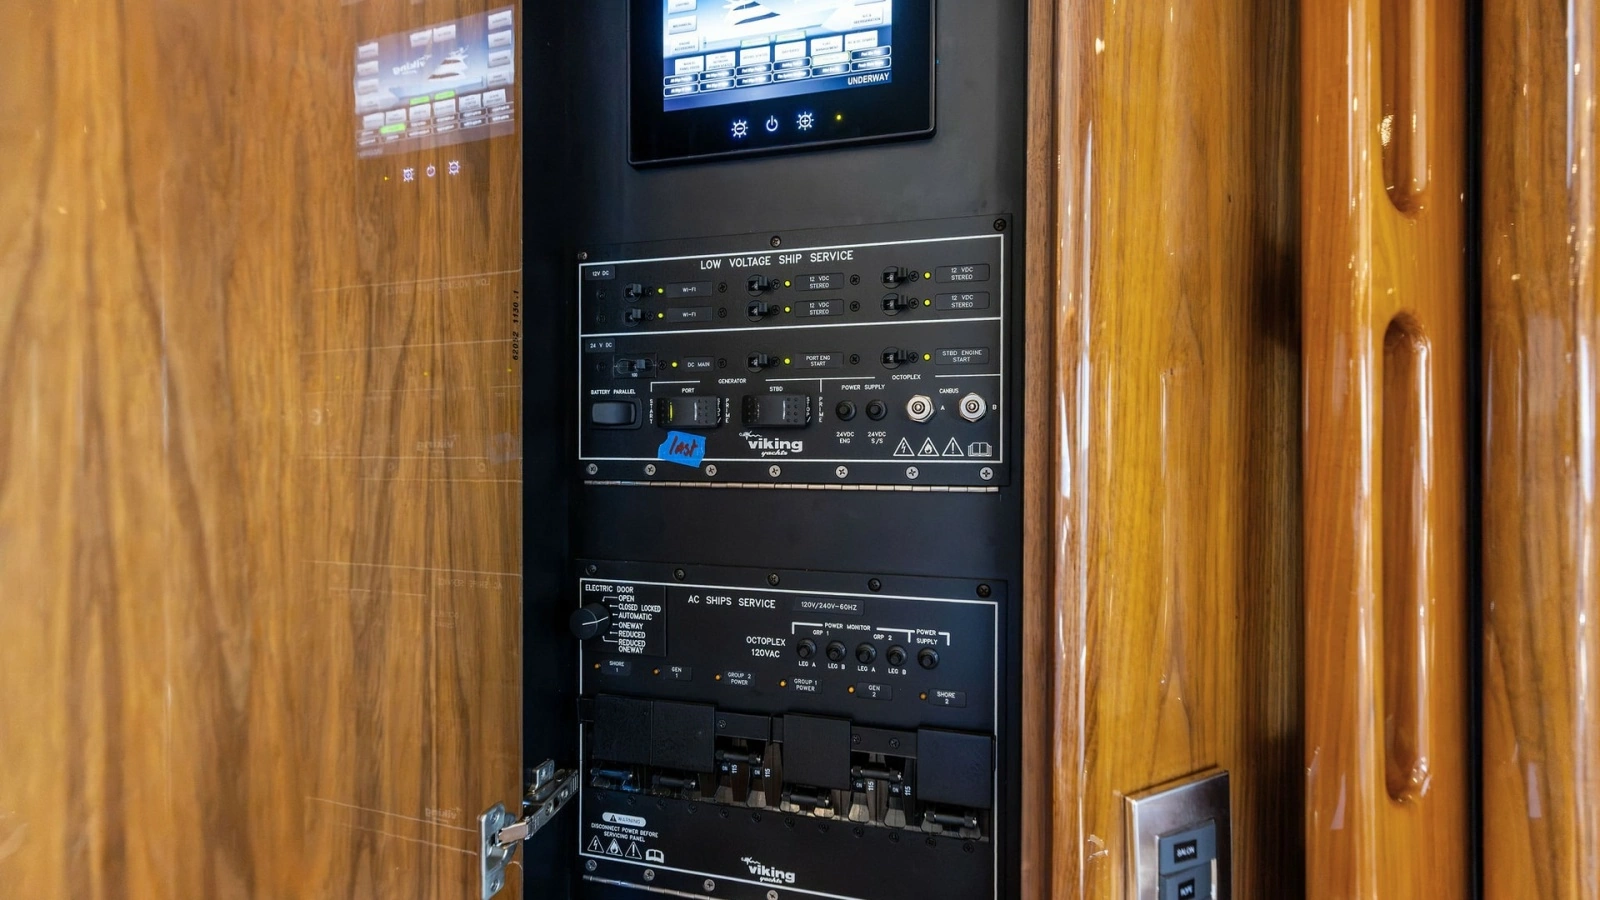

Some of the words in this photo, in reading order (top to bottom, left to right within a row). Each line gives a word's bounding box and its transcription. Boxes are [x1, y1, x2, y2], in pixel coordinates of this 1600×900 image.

[848, 72, 889, 85] UNDERWAY
[700, 260, 722, 270] LOW
[729, 256, 771, 268] VOLTAGE
[778, 254, 802, 264] SHIP
[810, 250, 854, 263] SERVICE
[748, 438, 803, 452] viking
[585, 584, 613, 592] ELECTRIC
[688, 595, 700, 604] AC
[706, 596, 732, 606] SHIPS
[738, 598, 776, 608] SERVICE
[801, 601, 858, 611] 120V/240V-60HZ
[618, 612, 652, 620] AUTOMATIC
[618, 622, 643, 630] ONEWAY
[618, 630, 646, 639] REDUCED
[618, 639, 646, 647] REDUCED
[746, 636, 786, 646] OCTOPLEX
[751, 649, 780, 658] 120VAC
[591, 823, 620, 832] DISCONNECT
[604, 831, 628, 840] SERVICING
[748, 864, 795, 884] viking
